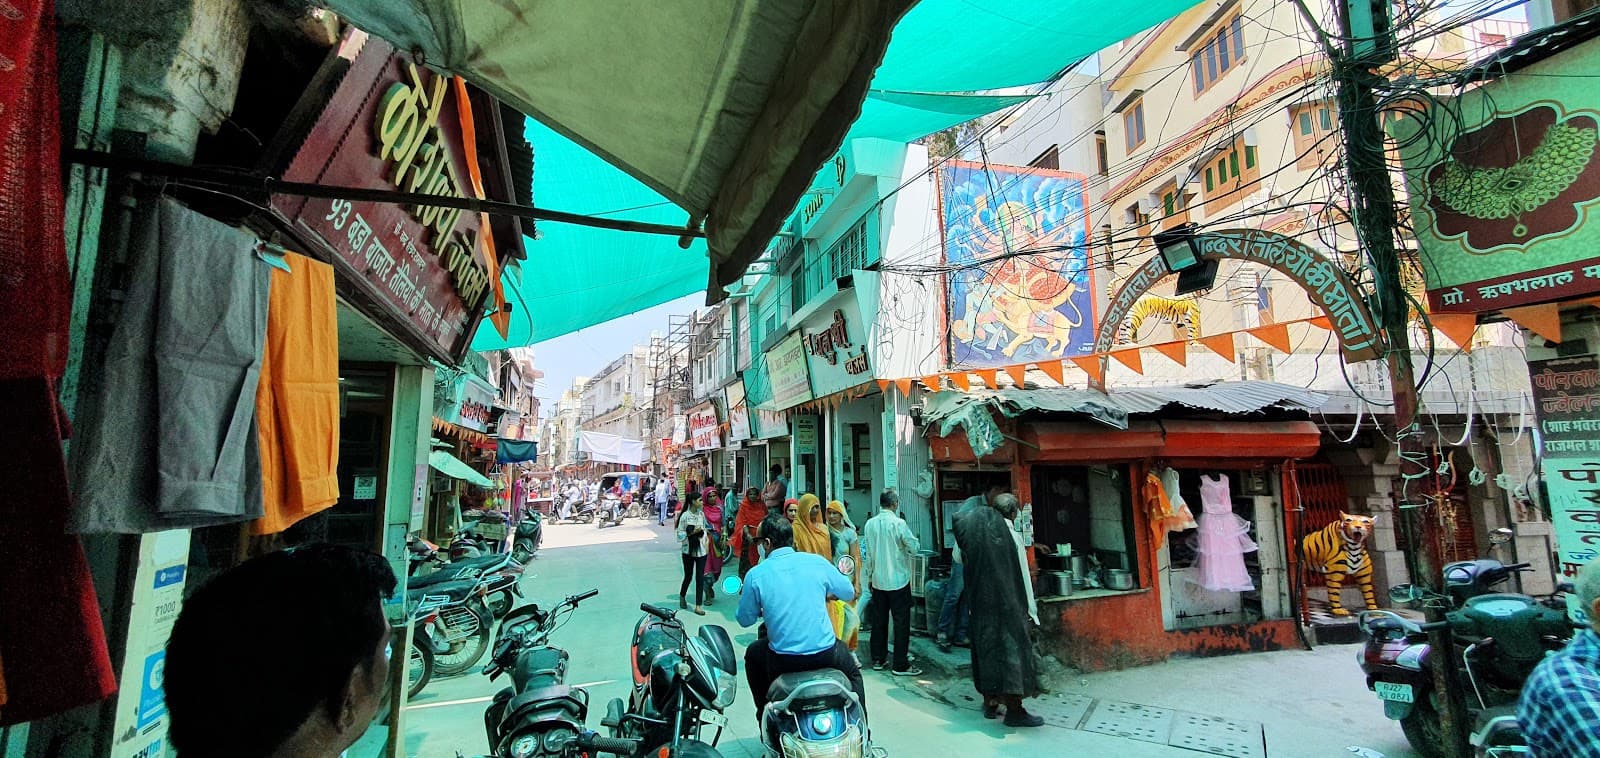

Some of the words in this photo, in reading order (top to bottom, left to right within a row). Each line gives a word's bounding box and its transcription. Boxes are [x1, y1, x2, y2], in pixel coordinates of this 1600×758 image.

[365, 236, 396, 282] बाजार
[419, 300, 436, 326] माता
[1305, 259, 1335, 294] की
[1442, 287, 1470, 305] प्रो.
[1477, 270, 1574, 299] ऋषभलाल
